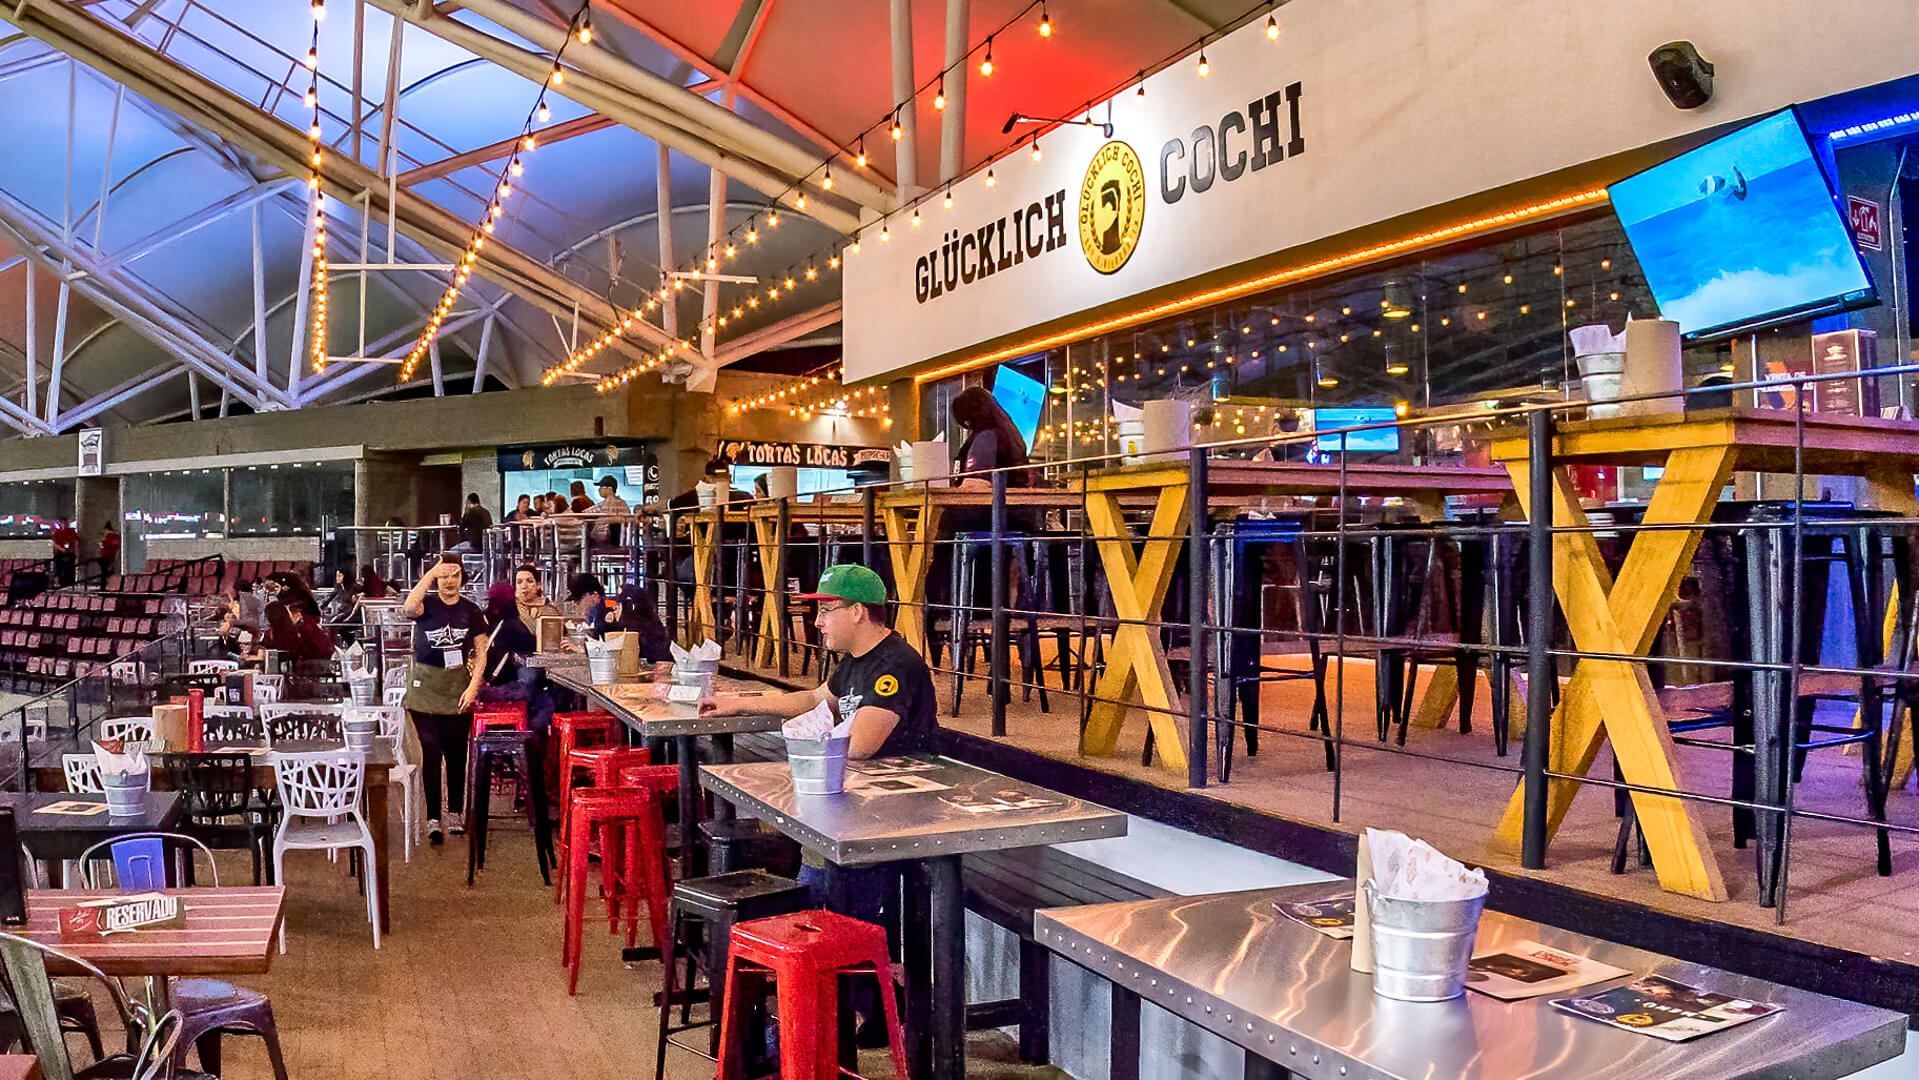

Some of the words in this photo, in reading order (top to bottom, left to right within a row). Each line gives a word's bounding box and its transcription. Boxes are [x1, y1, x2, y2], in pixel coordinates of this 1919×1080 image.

[1121, 151, 1143, 201] COCHI
[915, 188, 1068, 305] GLÜCKLICH
[1160, 80, 1306, 204] COCHI
[543, 446, 570, 467] TORTAS
[746, 441, 801, 465] TORTAS
[106, 897, 177, 929] RESERVADO
